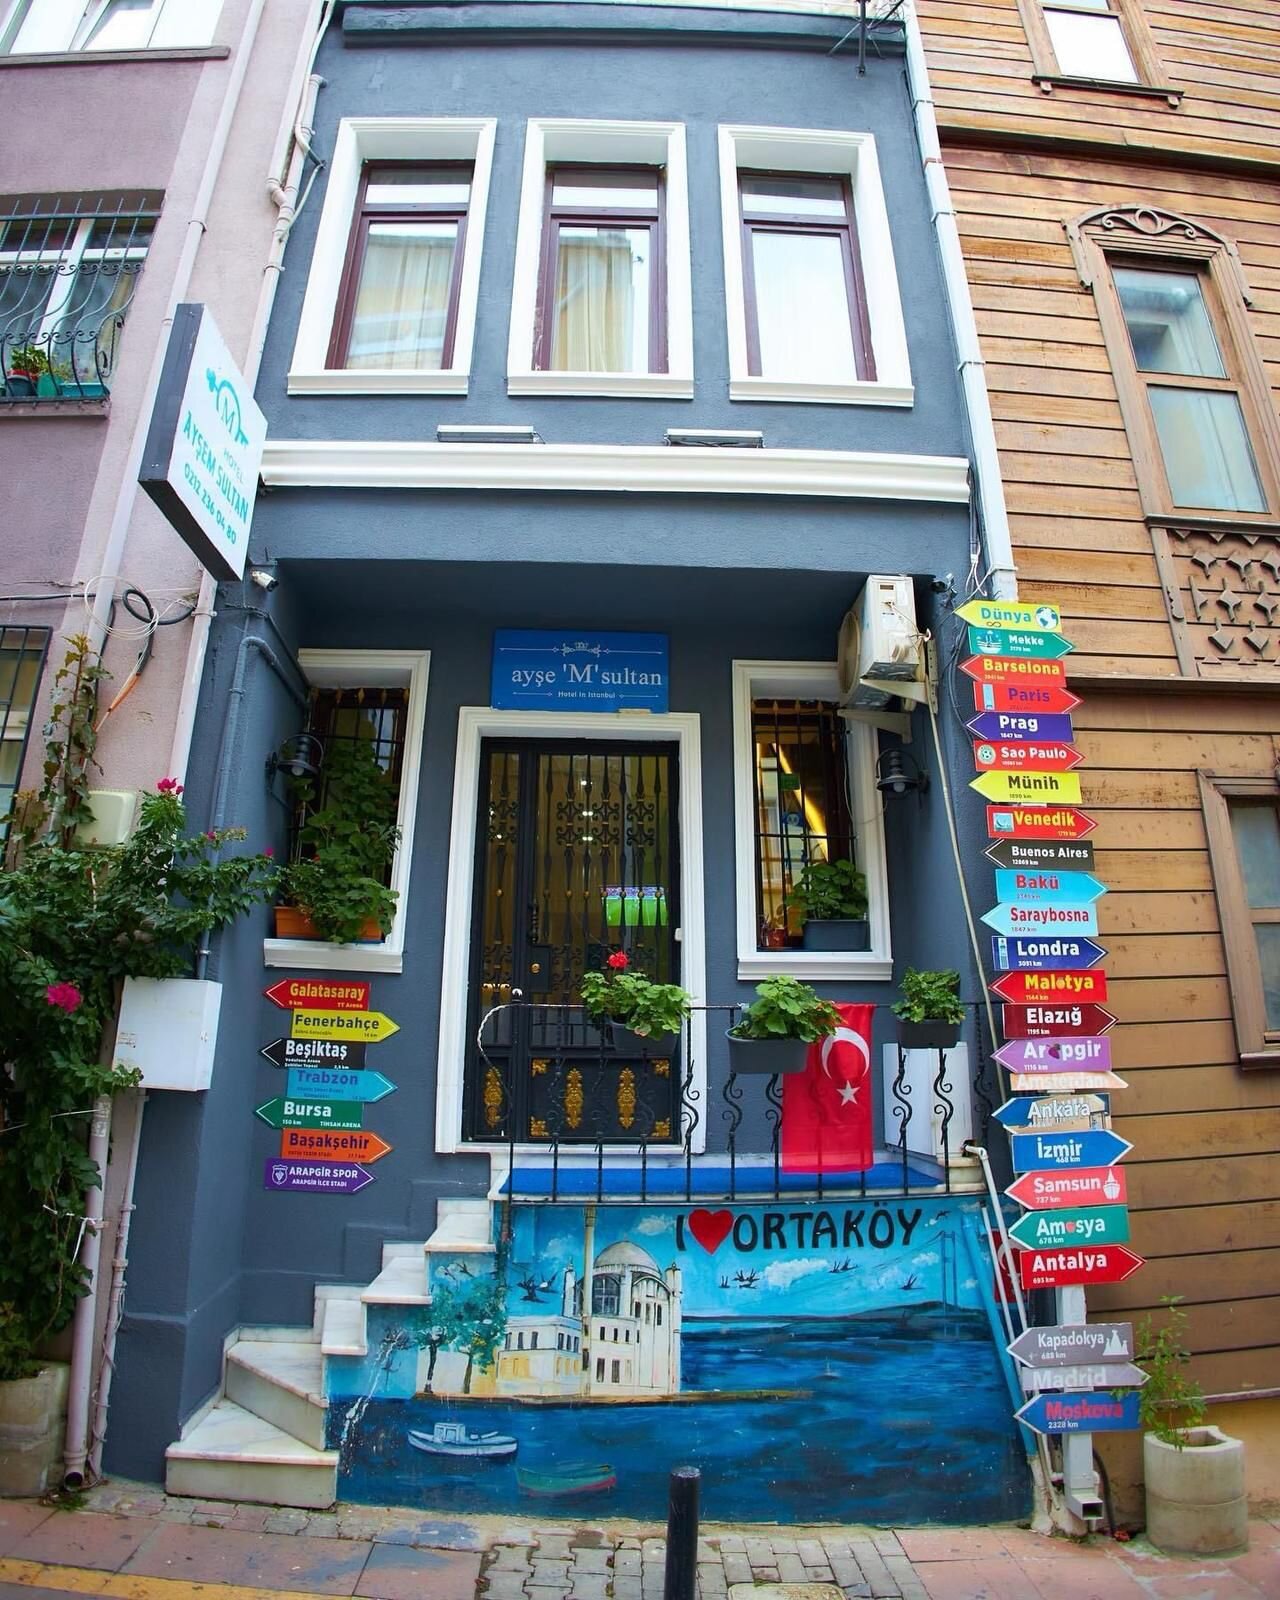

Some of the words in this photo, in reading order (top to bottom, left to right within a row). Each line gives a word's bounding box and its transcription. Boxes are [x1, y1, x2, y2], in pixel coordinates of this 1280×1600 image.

[182, 410, 216, 477] AYŞEM
[216, 465, 249, 524] SULTAN
[223, 448, 245, 485] HOTEL
[184, 463, 201, 496] 0212
[201, 488, 215, 514] 236
[216, 511, 225, 531] 04
[226, 528, 237, 545] 80
[981, 607, 1032, 623] Dünya
[1009, 634, 1044, 646] Mekke
[983, 659, 1060, 675] Barselona
[511, 669, 556, 687] ayşe
[601, 668, 663, 686] sultan
[1008, 688, 1050, 702] Paris
[999, 715, 1038, 732] Prag
[1001, 747, 1026, 758] Sao
[1029, 747, 1067, 759] Paulo
[1008, 775, 1059, 790] Münih
[1014, 811, 1076, 827] Venedik
[1011, 846, 1055, 858] Buenos
[1058, 847, 1088, 859] Aires
[1016, 875, 1058, 889] Bakü
[1010, 907, 1089, 924] Saraybosna
[1017, 940, 1080, 956] Londra
[1025, 974, 1094, 992] Maltya
[290, 983, 365, 1001] Galatasaray
[295, 1014, 379, 1031] Fenerbahçe
[1026, 1007, 1082, 1026] Elazığ
[286, 1040, 348, 1060] Beşiktaş
[1024, 1040, 1101, 1060] Arpgir
[297, 1070, 358, 1085] Trabzon
[284, 1101, 332, 1117] Bursa
[1027, 1100, 1091, 1119] Ankara
[289, 1133, 370, 1150] Başakşehir
[1037, 1137, 1083, 1159] İzmir
[289, 1166, 331, 1178] ARAPGİR
[333, 1168, 358, 1178] SPOR
[1034, 1177, 1101, 1194] Samsun
[676, 1214, 687, 1252] I
[732, 1201, 922, 1252] ORTAKÖY
[1036, 1218, 1105, 1238] Amsya
[1053, 1236, 1064, 1244] km
[1032, 1251, 1107, 1272] Antalya
[1038, 1330, 1104, 1350] Kapadokya
[1032, 1367, 1106, 1388] Madrid
[1045, 1399, 1123, 1419] Moskova
[1048, 1421, 1066, 1429] 2328
[1067, 1420, 1079, 1428] km
